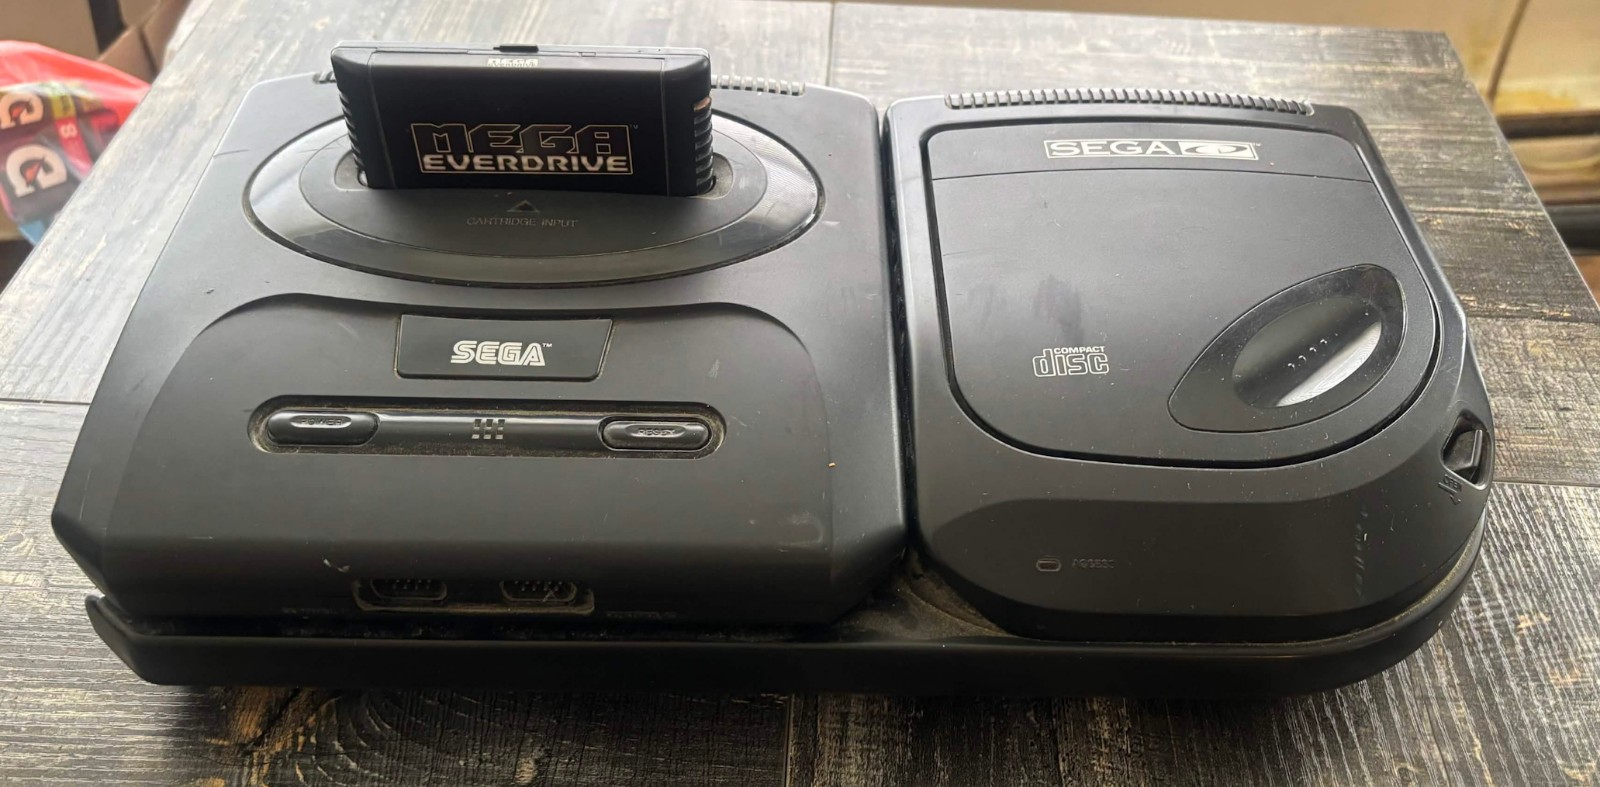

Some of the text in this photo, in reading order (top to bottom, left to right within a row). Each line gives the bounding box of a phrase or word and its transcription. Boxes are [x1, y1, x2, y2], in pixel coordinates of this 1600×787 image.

[411, 124, 630, 155] MEGA
[1050, 141, 1177, 156] SEGA
[6, 144, 67, 197] G
[422, 154, 630, 173] EVERDRIVE
[466, 216, 579, 229] CARTRIDGE INPUT
[450, 340, 546, 367] SEGA
[1053, 345, 1106, 354] COMPACT
[1032, 348, 1110, 378] disc
[299, 417, 343, 426] POWER
